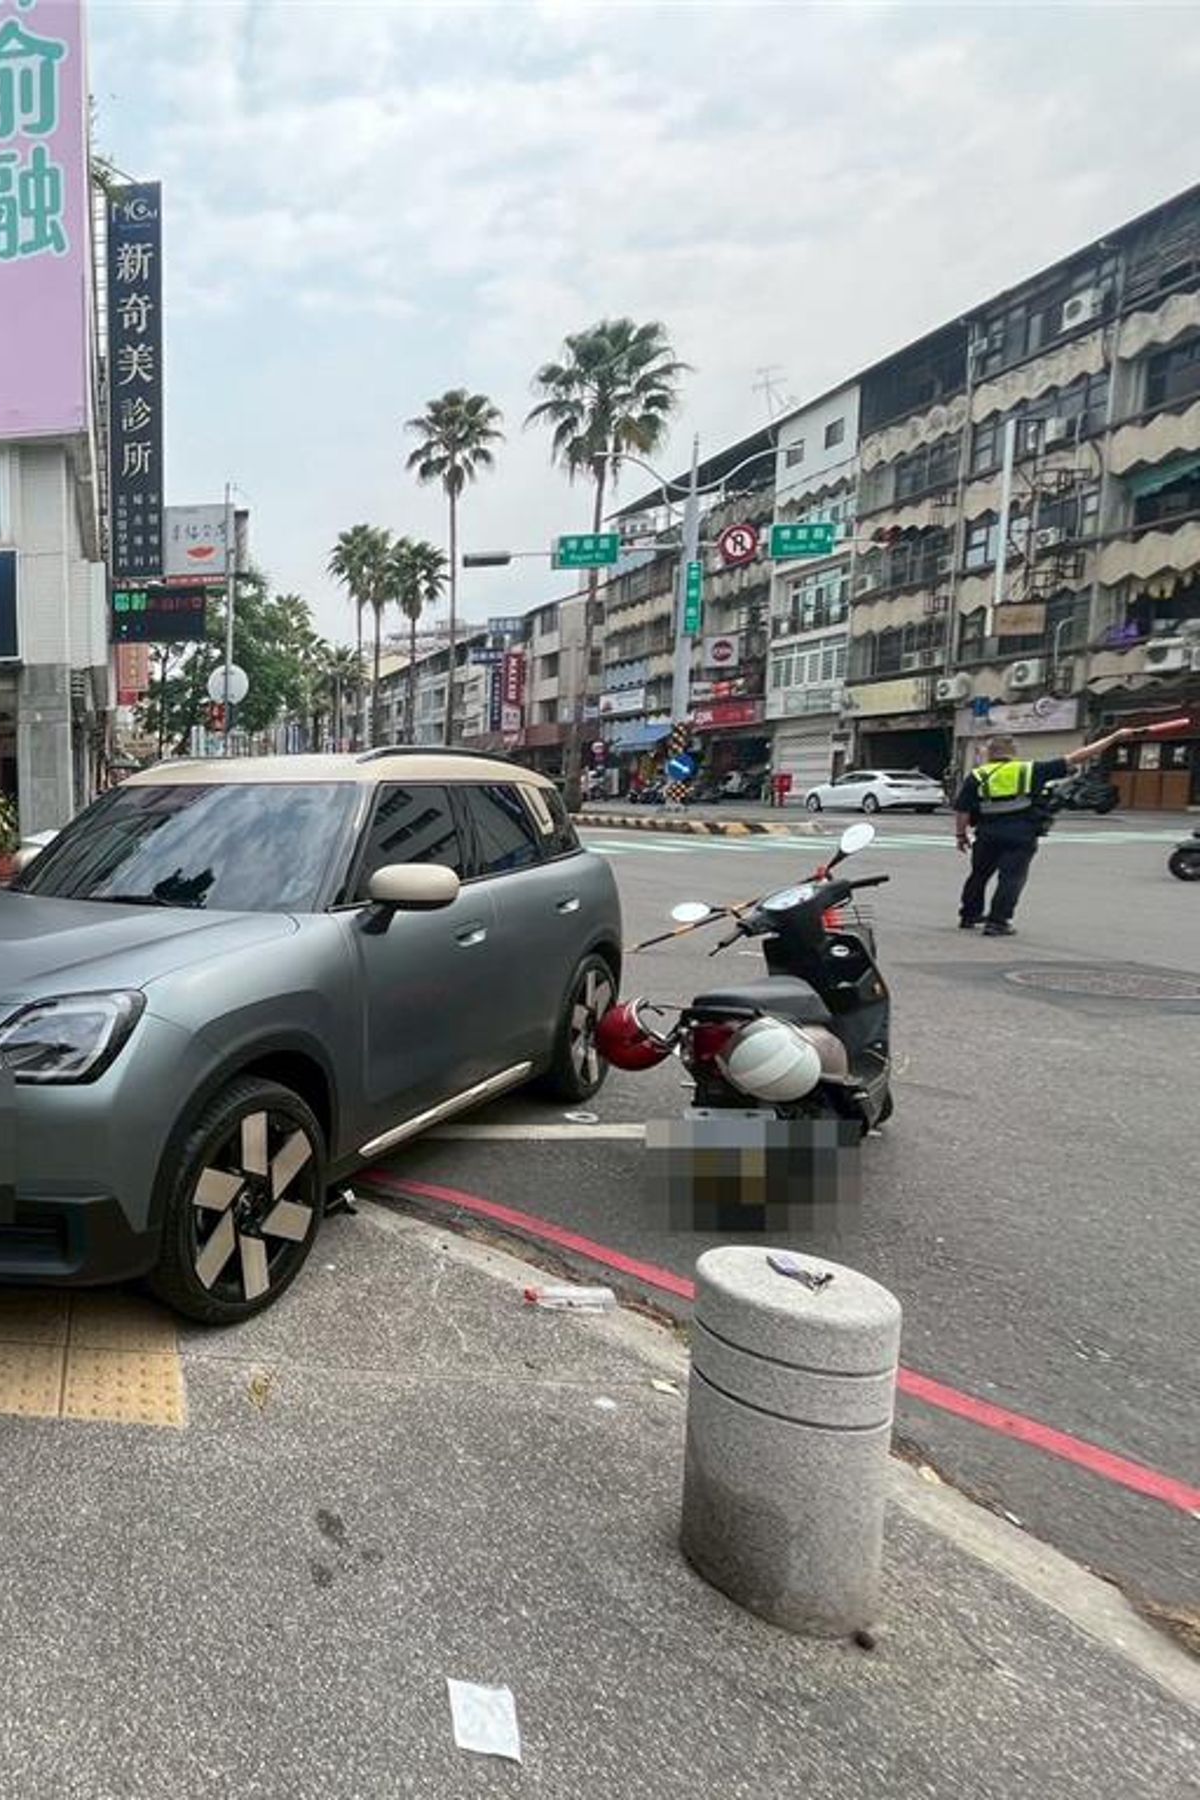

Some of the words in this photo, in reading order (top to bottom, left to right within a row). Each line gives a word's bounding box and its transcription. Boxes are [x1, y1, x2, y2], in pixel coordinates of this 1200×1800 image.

[116, 242, 154, 478] 新奇美診所
